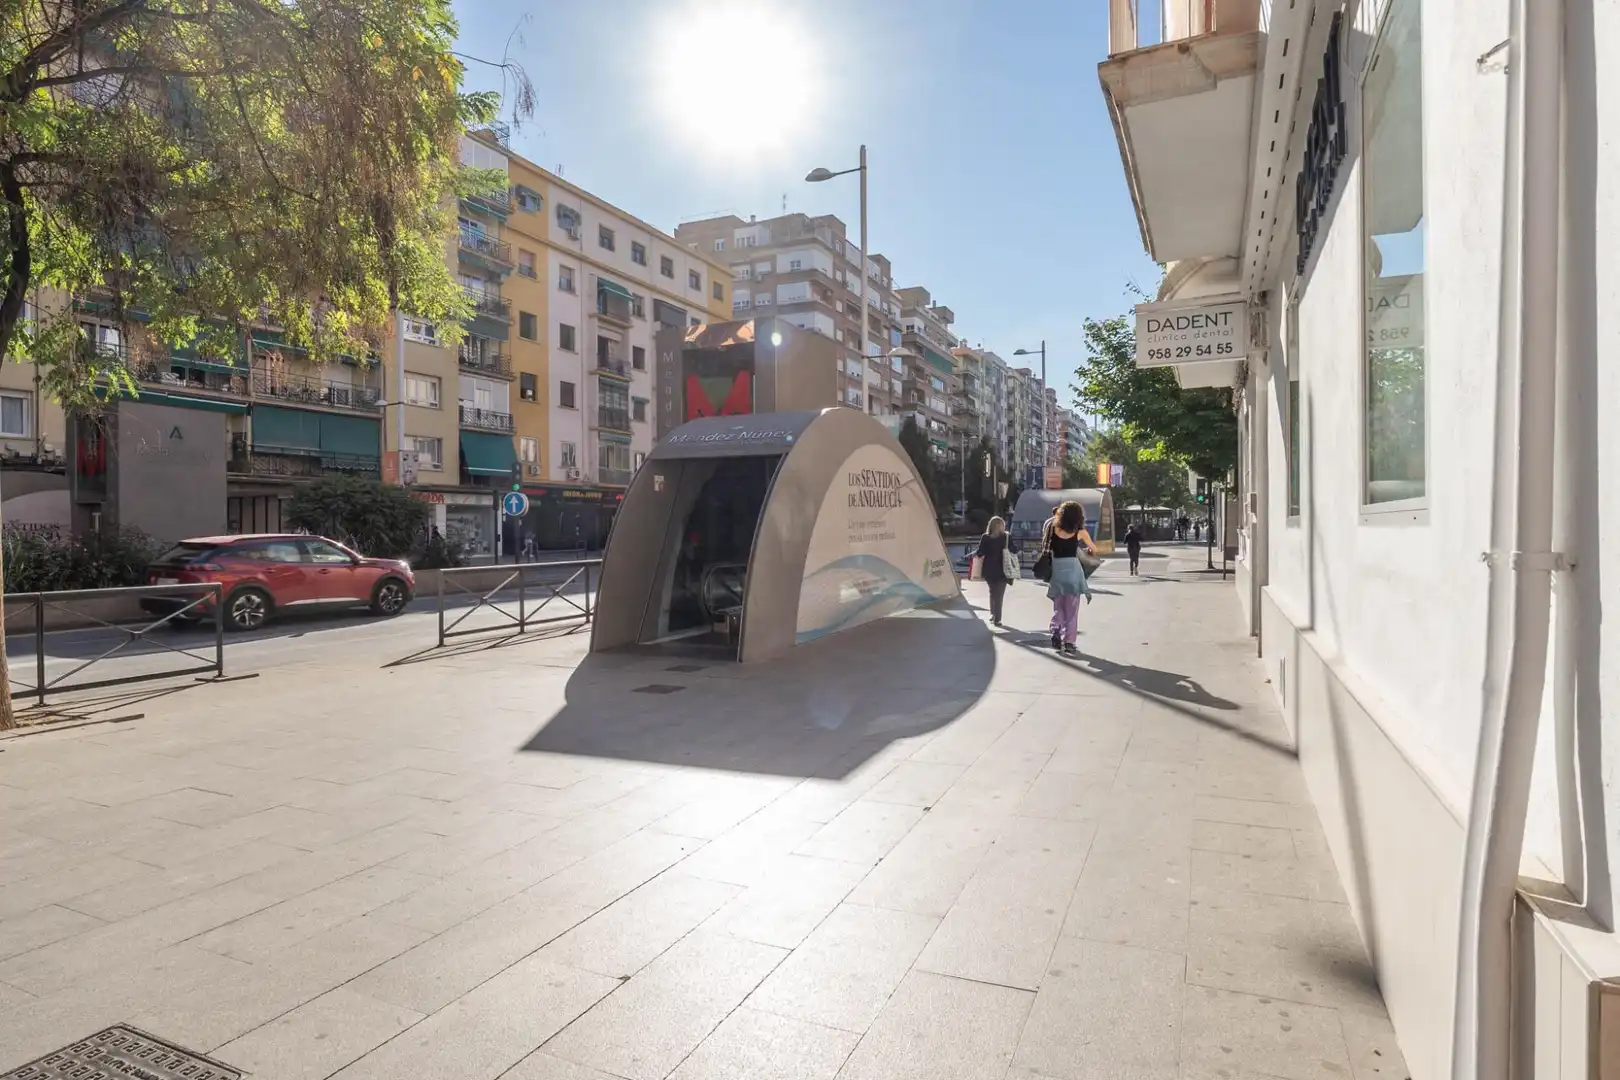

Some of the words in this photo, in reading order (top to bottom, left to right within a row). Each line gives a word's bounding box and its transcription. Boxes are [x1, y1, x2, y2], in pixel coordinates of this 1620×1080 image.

[1147, 311, 1233, 333] DADENT
[1195, 328, 1235, 340] dental
[1147, 348, 1172, 360] 958
[1176, 346, 1192, 358] 29
[1196, 345, 1212, 357] 54
[1216, 342, 1233, 354] 55
[848, 472, 861, 487] LOS
[861, 469, 901, 489] SENTIDOS
[848, 493, 857, 507] DE
